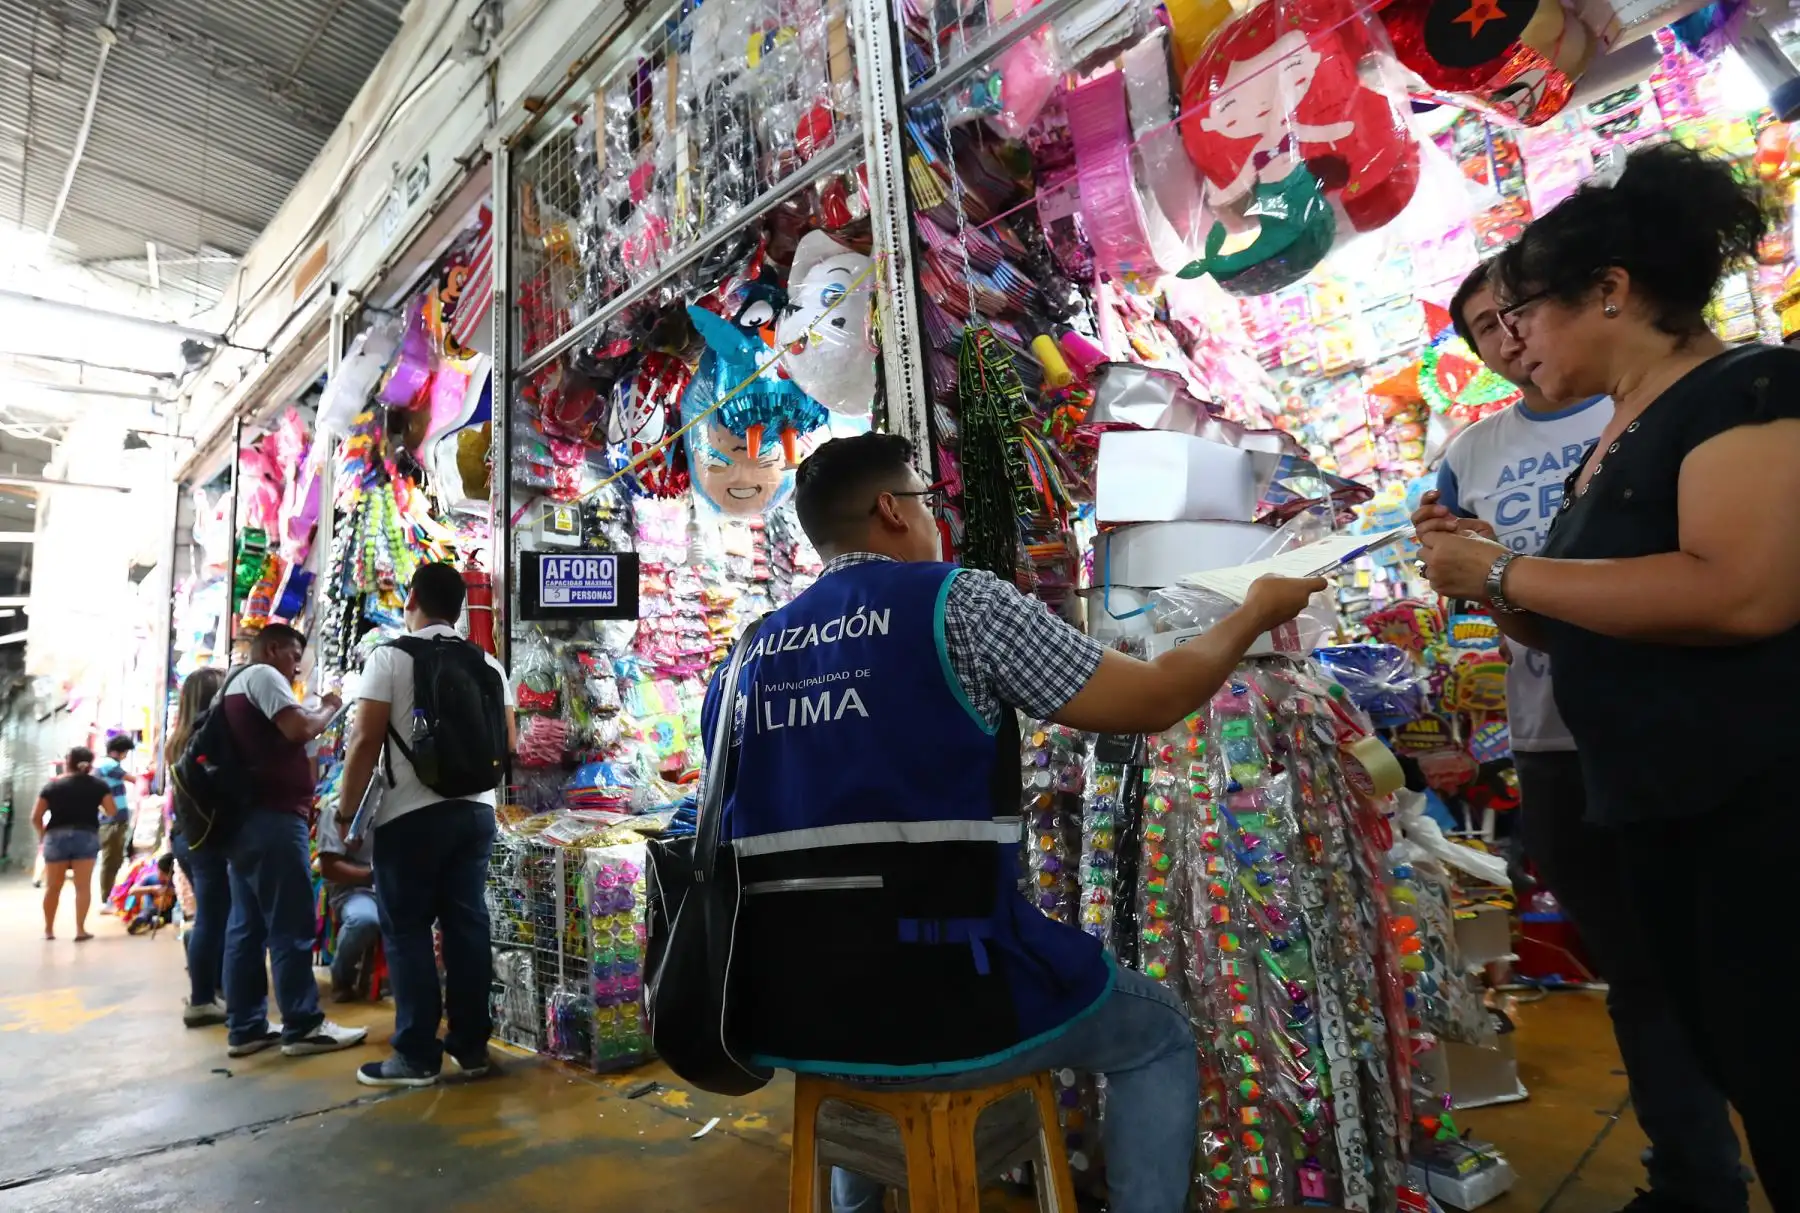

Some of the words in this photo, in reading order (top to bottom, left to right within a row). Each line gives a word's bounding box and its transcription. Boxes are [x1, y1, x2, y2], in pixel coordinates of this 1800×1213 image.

[545, 559, 612, 579] AFORO
[572, 590, 612, 600] PERSONAS
[765, 671, 850, 692] MUNICIPALIDAD
[855, 668, 871, 679] DE
[765, 688, 869, 731] LIMA
